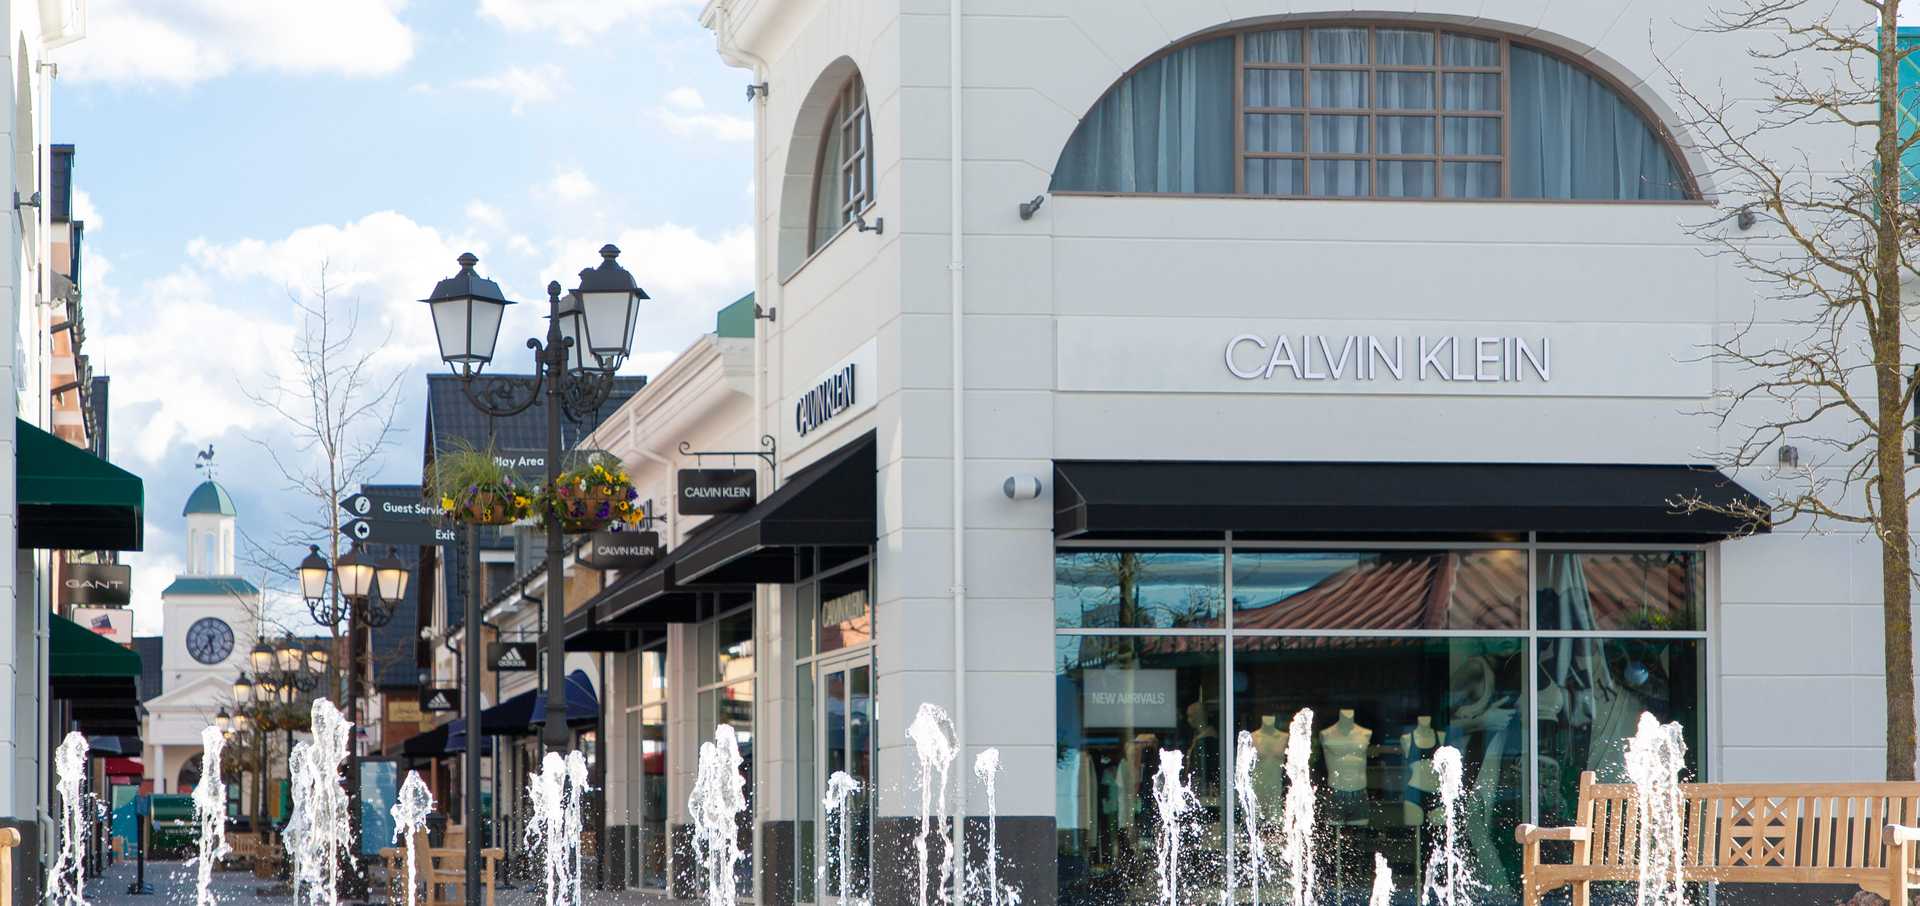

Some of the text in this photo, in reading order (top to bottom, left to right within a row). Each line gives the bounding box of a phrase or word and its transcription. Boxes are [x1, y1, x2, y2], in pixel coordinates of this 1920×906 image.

[1225, 334, 1550, 381] CALVIN KLEIN
[796, 363, 856, 437] CALVIN KLEIN
[518, 456, 545, 466] Area
[684, 487, 751, 498] CALVIN KLEIN
[382, 502, 448, 516] Guest Servic
[435, 529, 456, 541] Exit
[598, 546, 655, 556] CALVIN KLEIN
[65, 579, 124, 589] GANT
[1092, 692, 1166, 705] NEW ARRIVALS
